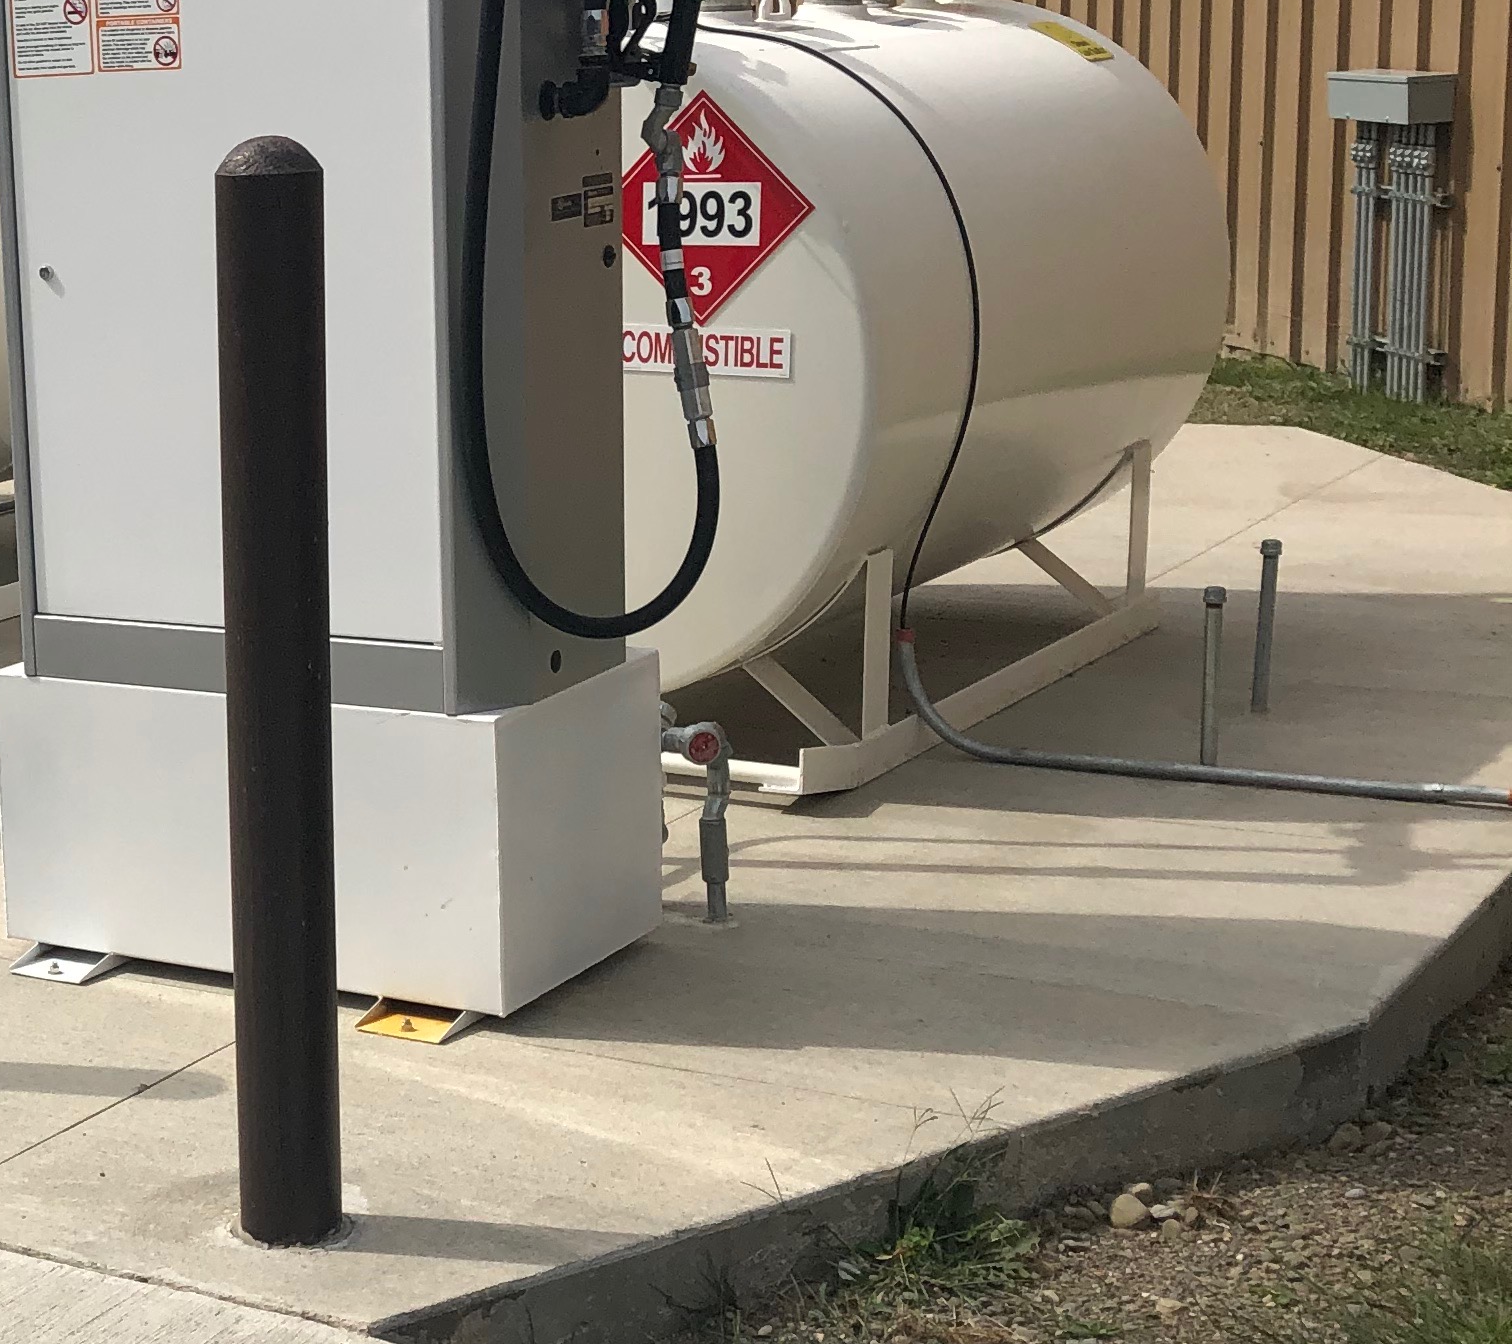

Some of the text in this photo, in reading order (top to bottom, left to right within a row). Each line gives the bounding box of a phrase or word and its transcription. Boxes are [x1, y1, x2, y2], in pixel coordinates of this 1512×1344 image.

[648, 190, 753, 238] 993
[690, 266, 713, 296] 3
[622, 329, 784, 370] COMSTIBLE
